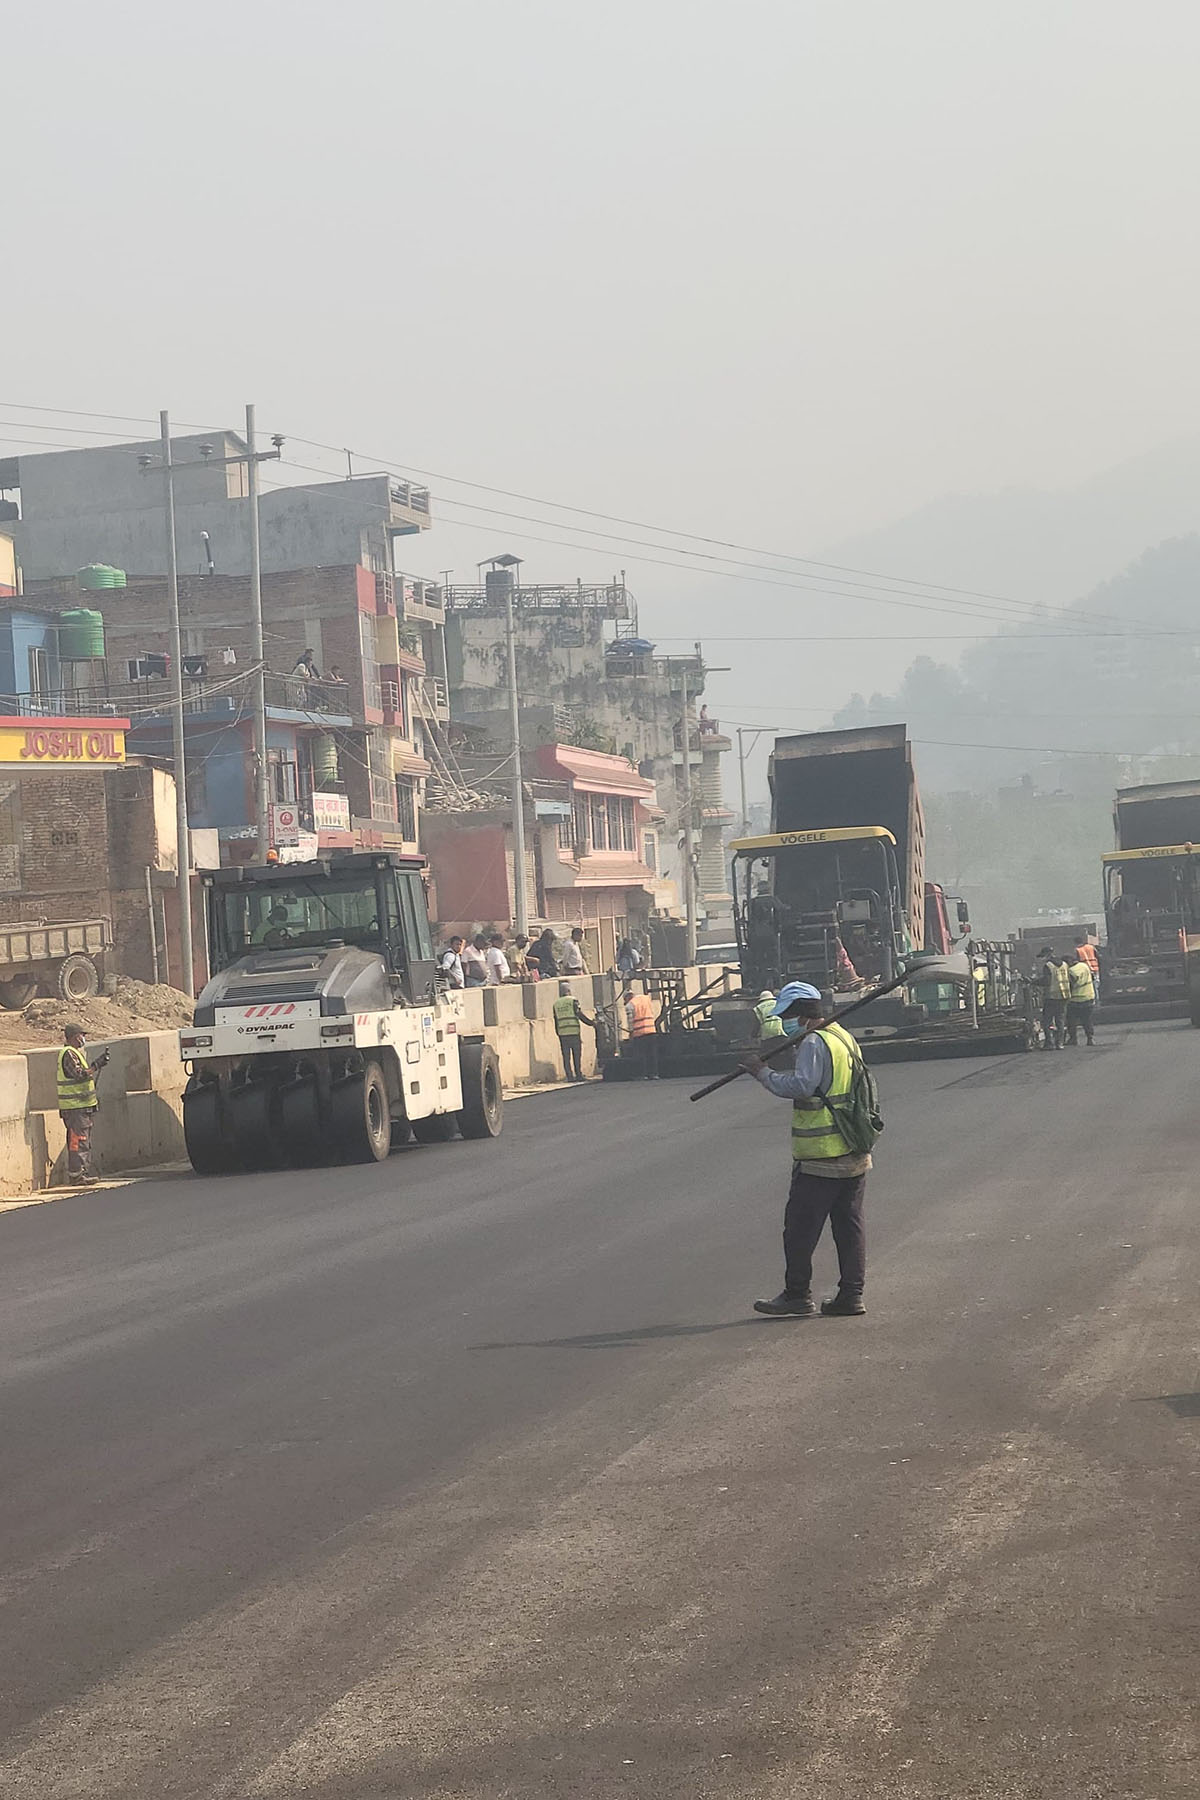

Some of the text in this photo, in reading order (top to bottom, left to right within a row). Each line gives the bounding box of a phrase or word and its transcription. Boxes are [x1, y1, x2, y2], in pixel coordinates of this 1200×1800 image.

[20, 731, 122, 757] JOSHI OIL
[780, 833, 826, 844] VÖGELE
[246, 1023, 295, 1033] DYNAPAC
